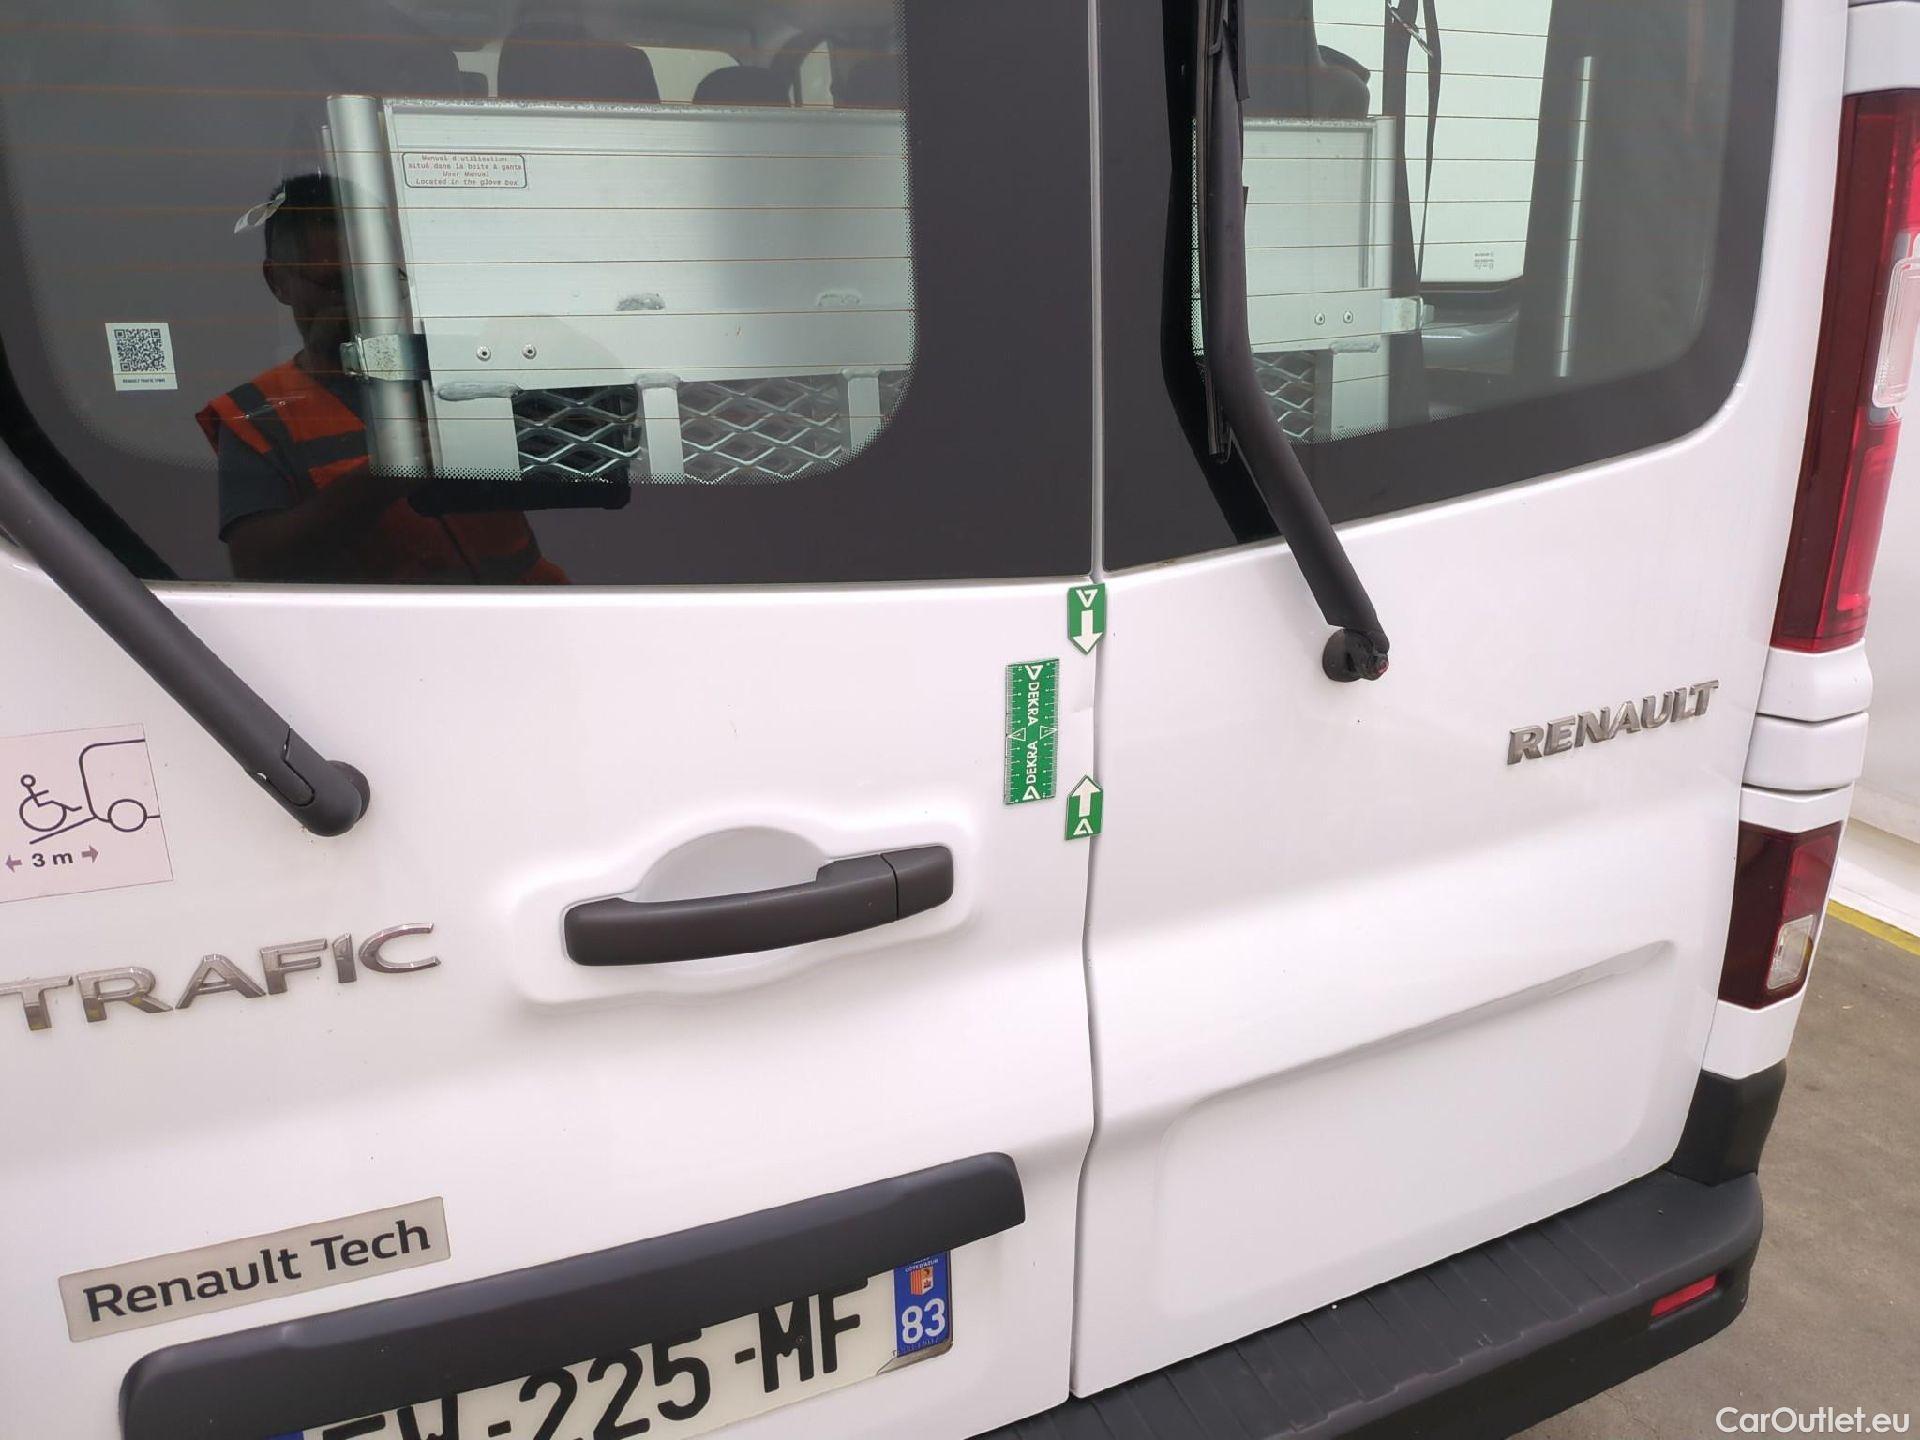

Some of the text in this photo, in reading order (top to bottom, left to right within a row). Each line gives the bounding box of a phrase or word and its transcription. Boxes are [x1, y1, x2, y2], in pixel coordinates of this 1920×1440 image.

[1028, 682, 1040, 727] DEKRA
[1507, 679, 1719, 765] RENAULT
[1026, 740, 1038, 785] DEKRA
[31, 852, 73, 867] 3 m
[0, 921, 441, 1031] TRAFIC
[83, 1219, 431, 1322] Renault Tech
[902, 1298, 945, 1344] 83
[322, 1280, 868, 1440] W-225-MF
